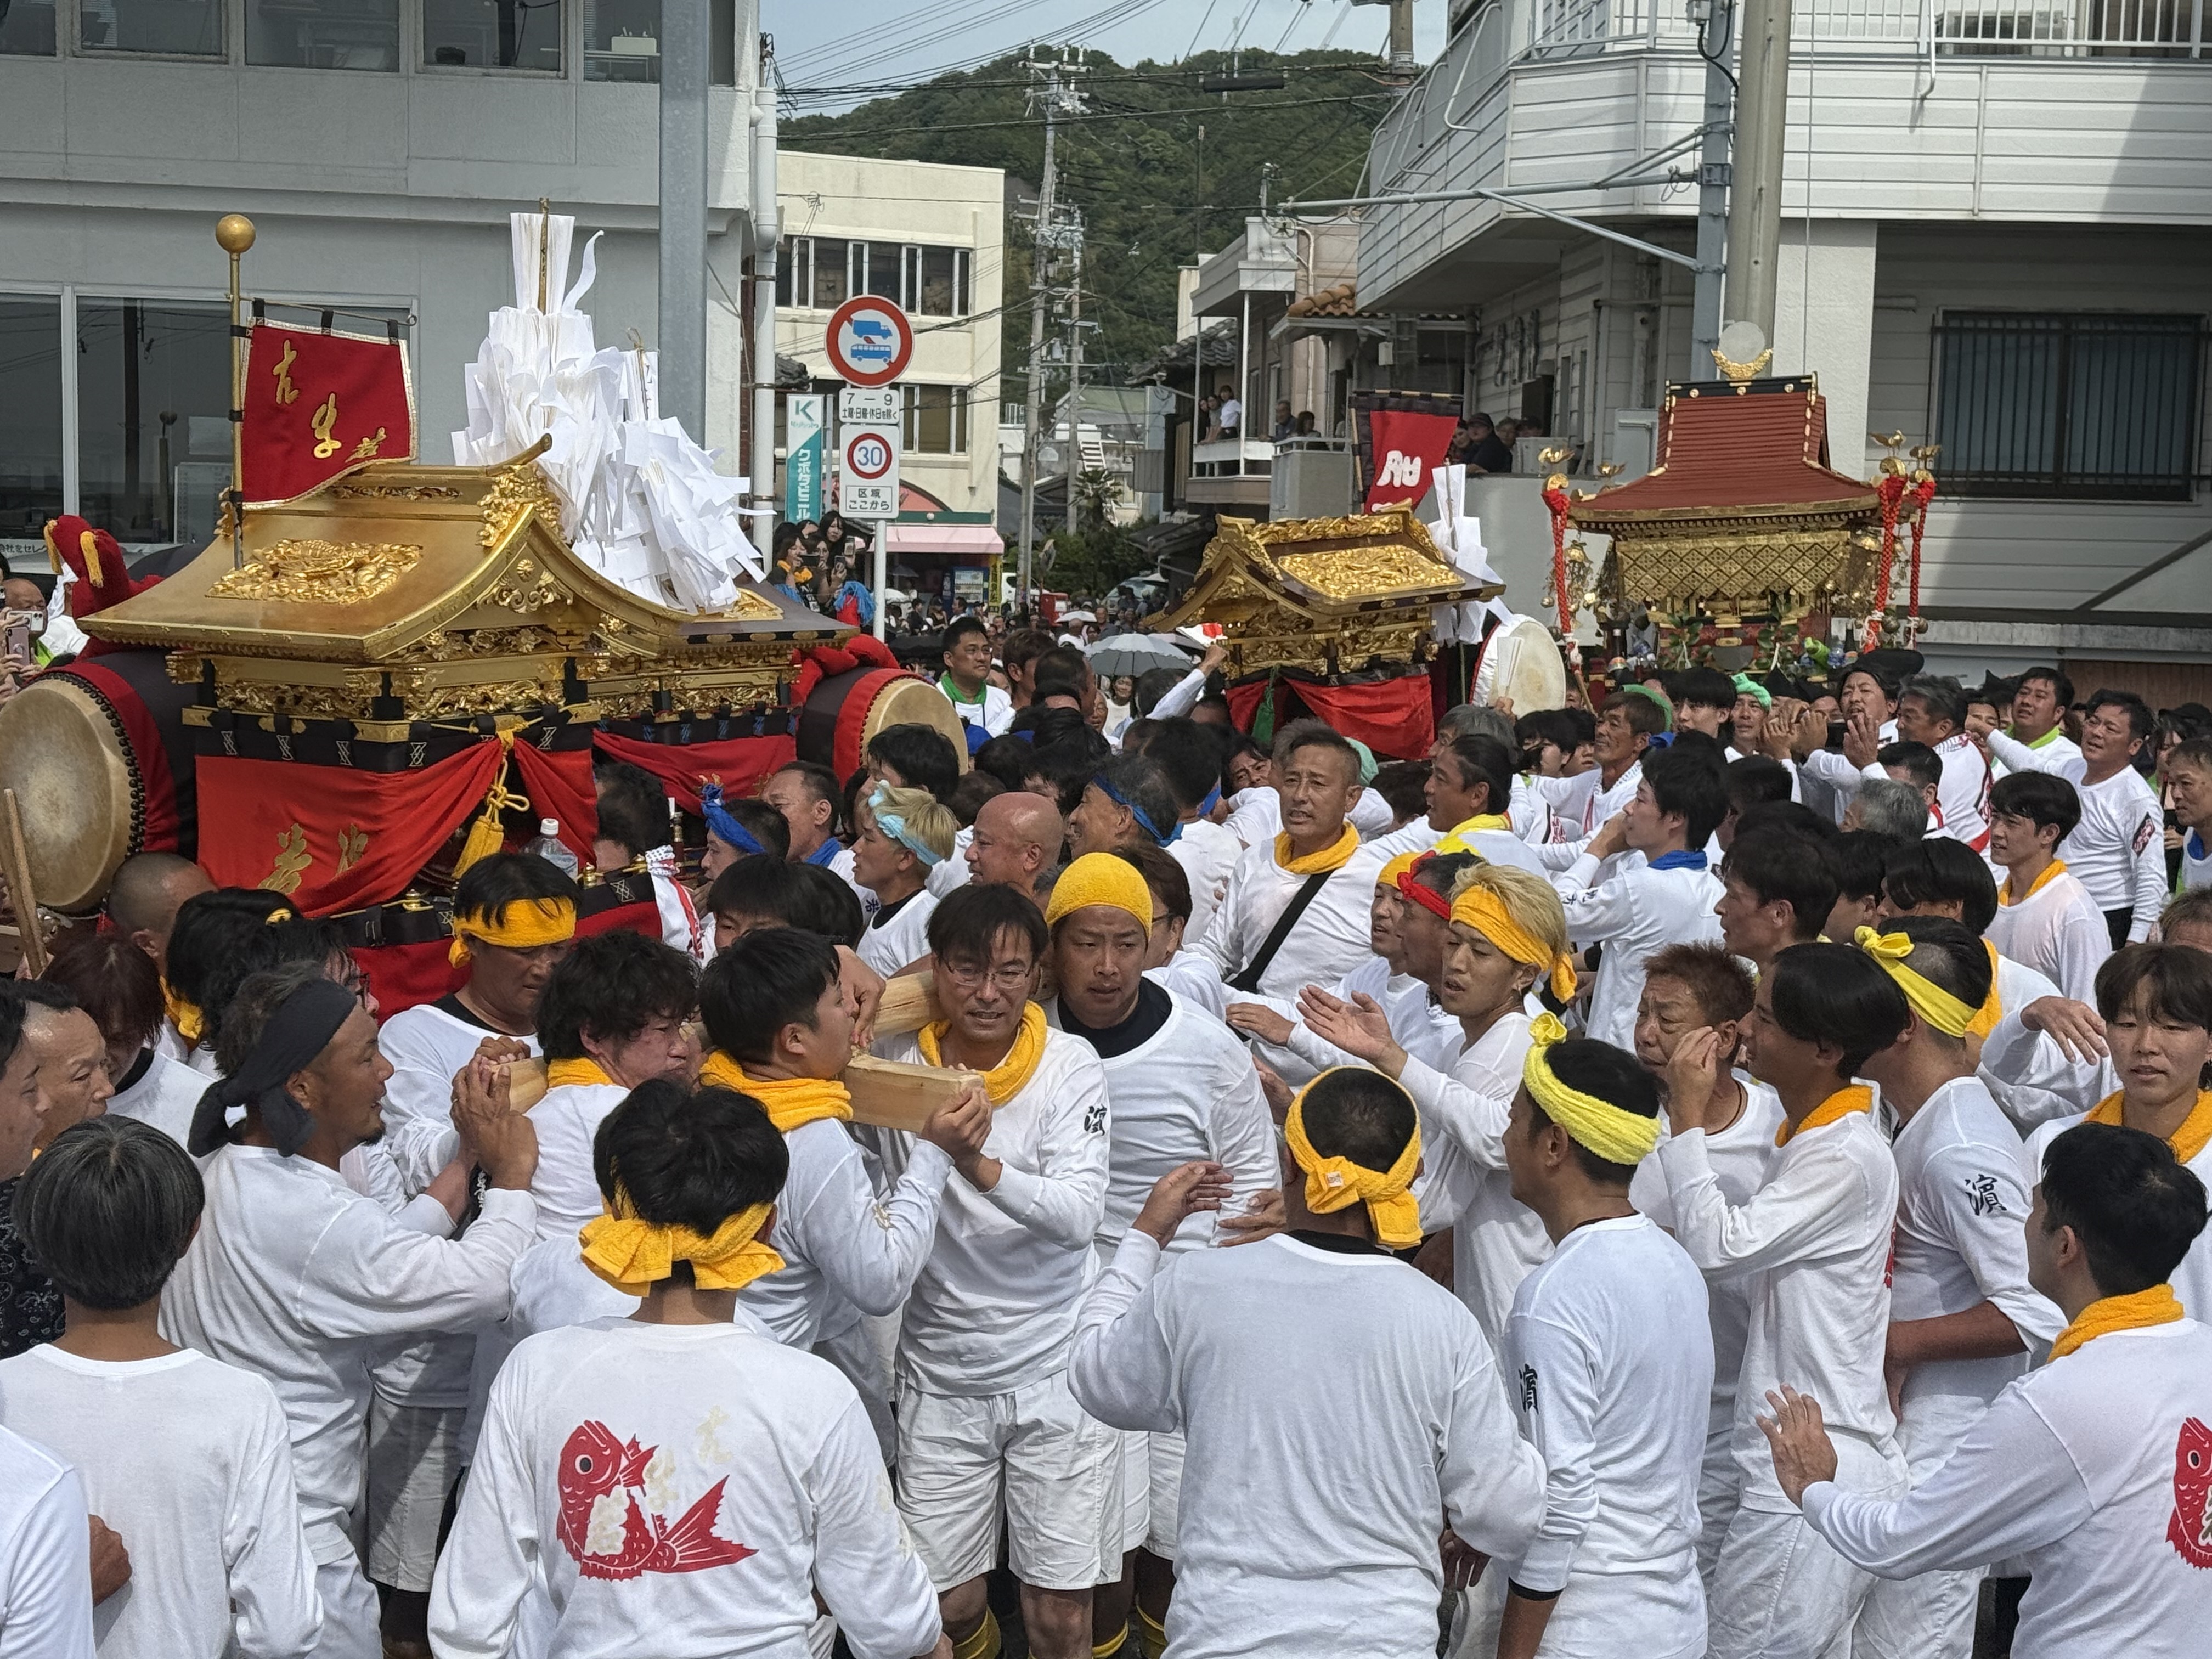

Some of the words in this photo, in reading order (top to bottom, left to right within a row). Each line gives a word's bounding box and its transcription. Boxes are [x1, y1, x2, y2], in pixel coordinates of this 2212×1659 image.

[857, 446, 883, 466] 30
[858, 488, 881, 499] 区域
[849, 500, 890, 510] ここから
